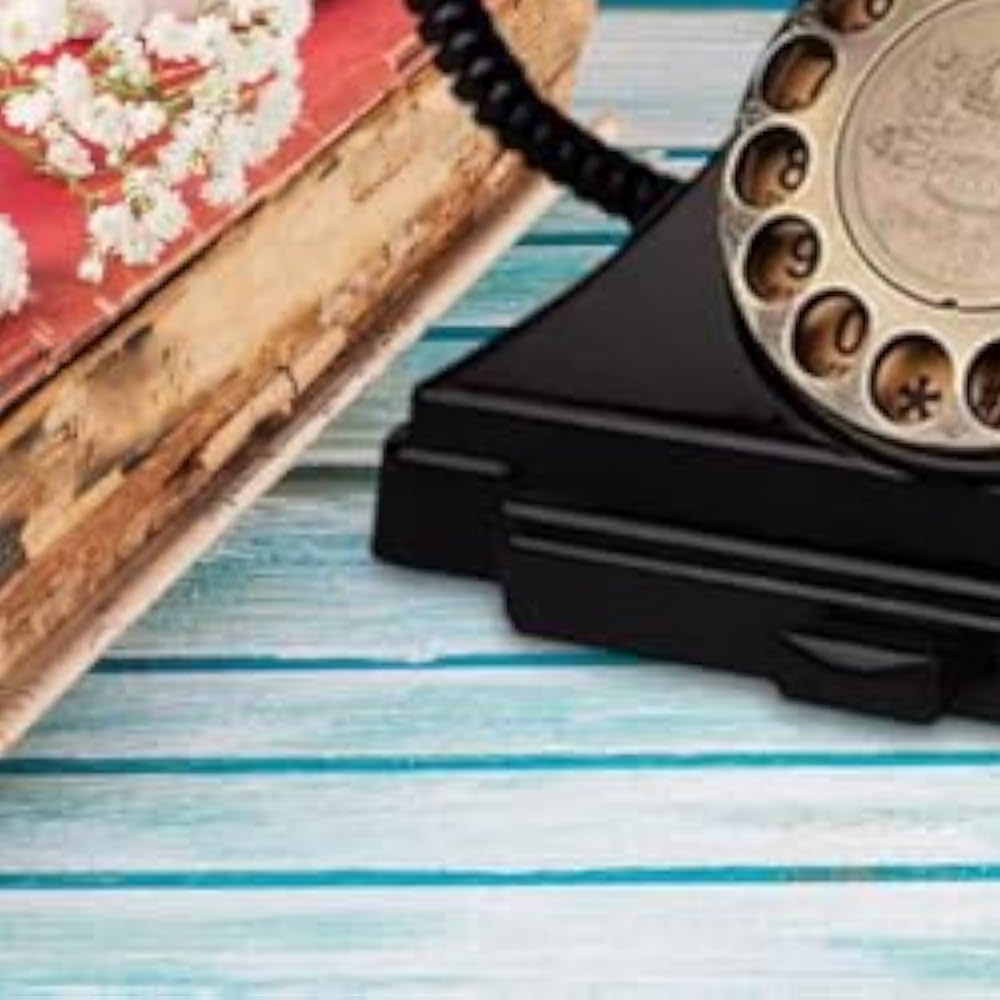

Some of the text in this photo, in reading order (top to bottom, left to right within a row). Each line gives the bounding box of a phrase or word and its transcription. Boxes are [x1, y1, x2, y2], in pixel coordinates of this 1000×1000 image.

[778, 145, 810, 191] 8
[785, 230, 819, 279] 9
[834, 304, 868, 357] 0
